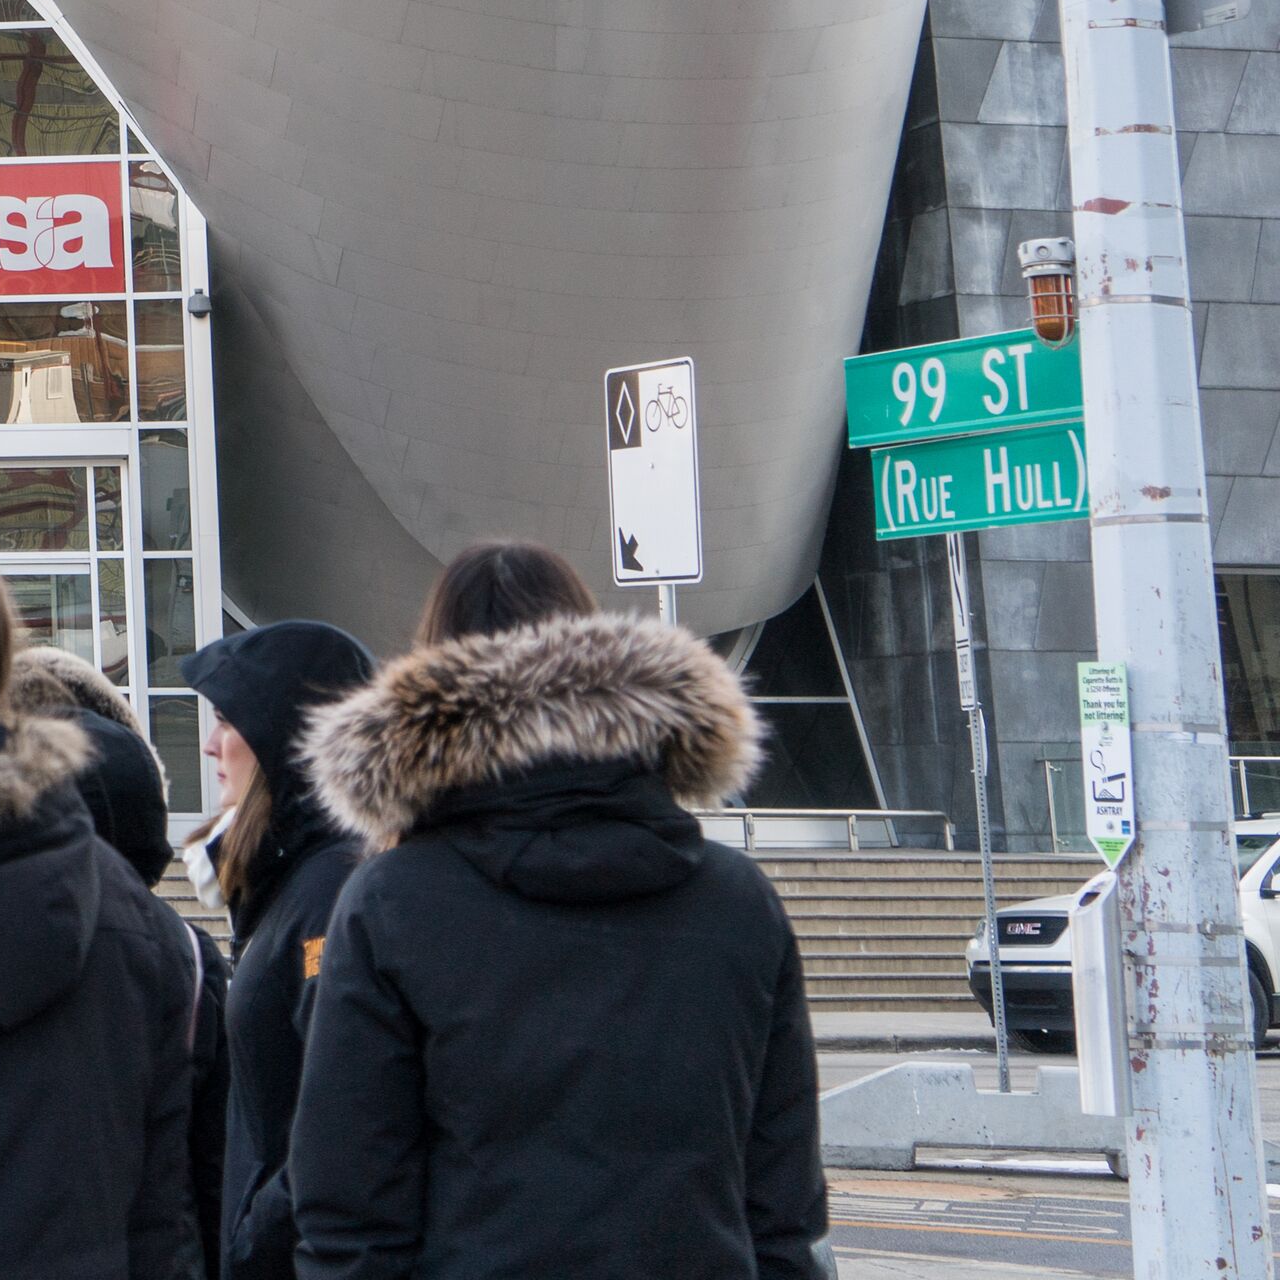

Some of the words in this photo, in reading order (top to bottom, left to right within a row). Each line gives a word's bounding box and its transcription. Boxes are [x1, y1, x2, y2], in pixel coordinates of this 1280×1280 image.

[892, 357, 947, 427] 99
[981, 343, 1033, 415] ST
[1083, 699, 1102, 709] Thank
[1096, 806, 1123, 816] ASHTRAY
[1006, 922, 1042, 935] GMC
